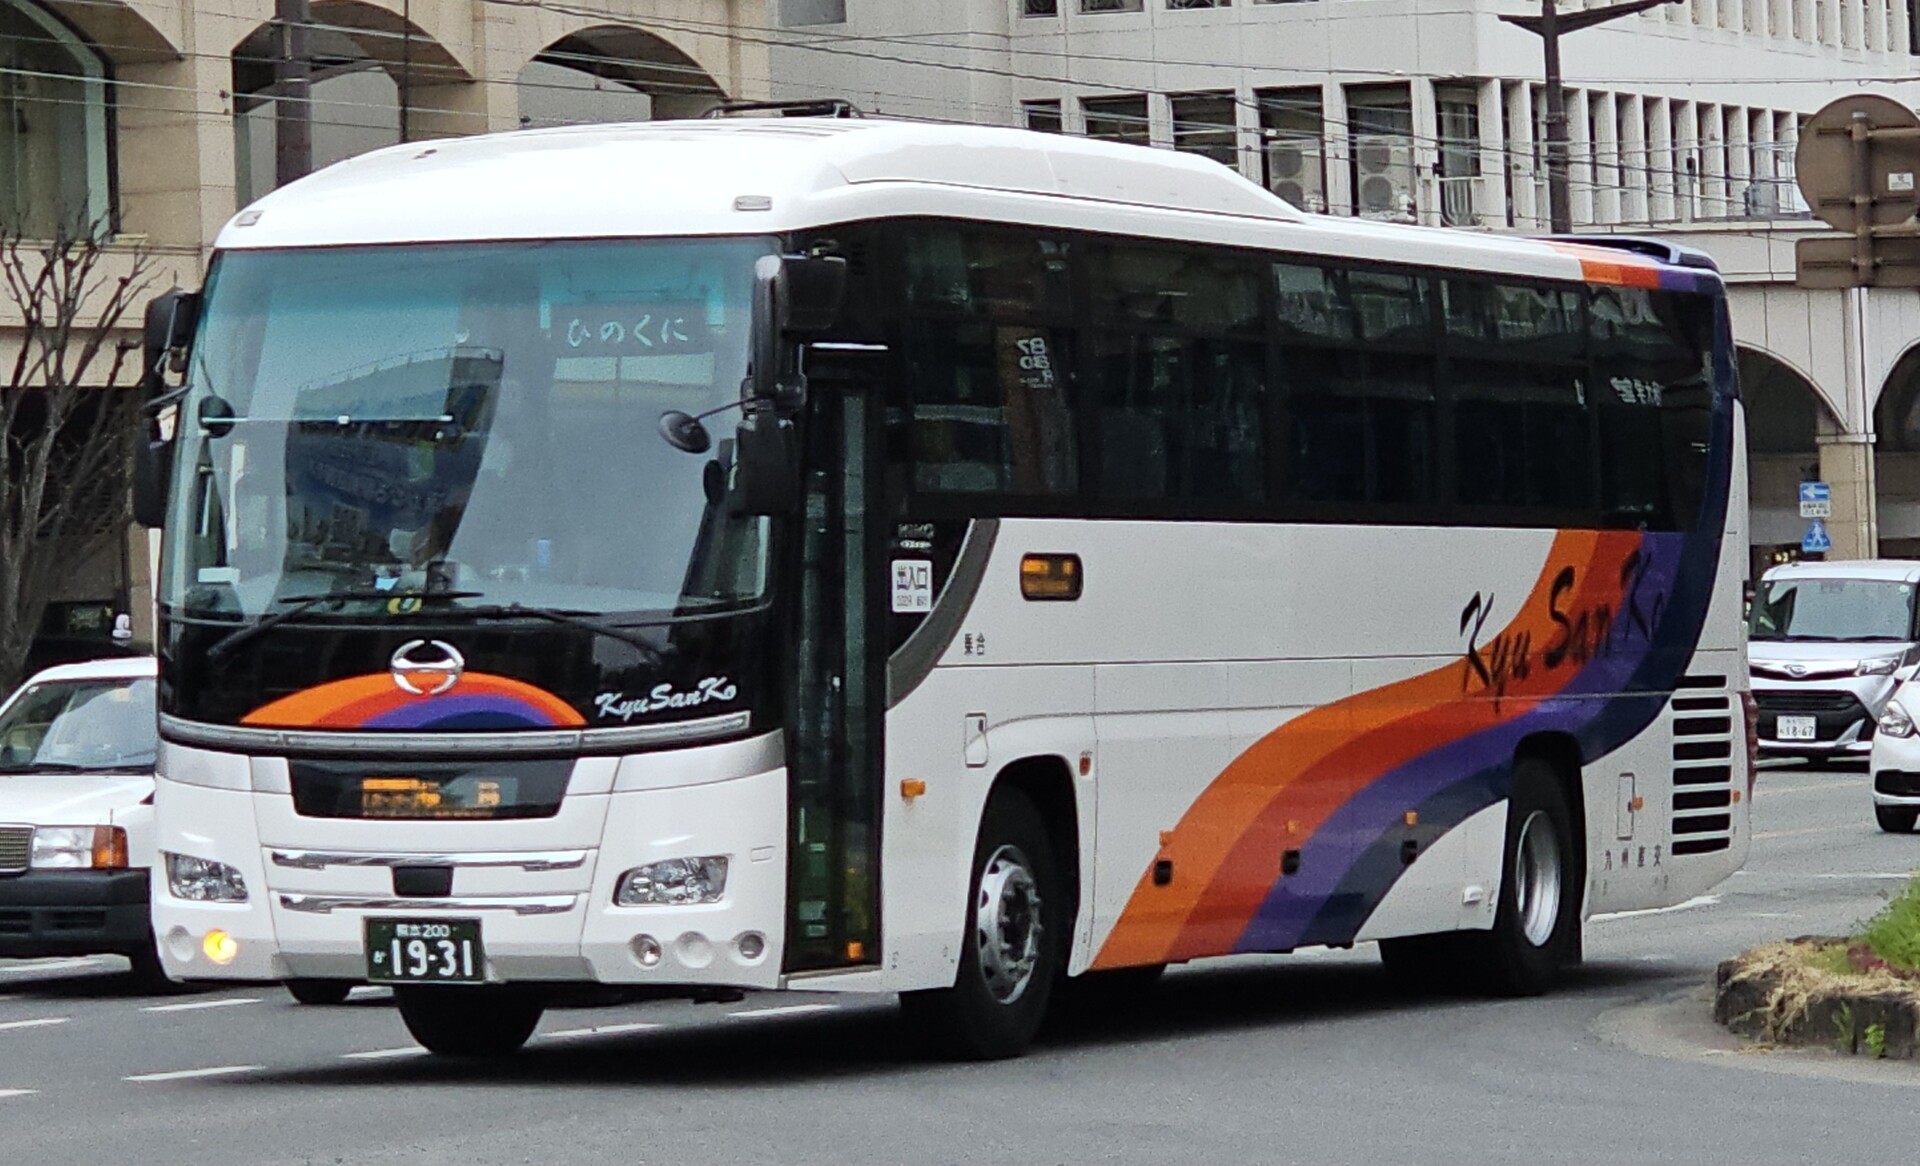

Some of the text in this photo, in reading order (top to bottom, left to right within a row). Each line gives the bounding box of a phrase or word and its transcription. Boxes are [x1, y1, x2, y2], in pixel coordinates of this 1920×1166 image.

[567, 314, 688, 348] ひのくに
[896, 565, 929, 590] 出入口
[1460, 590, 1531, 715] Kyu
[1544, 565, 1611, 669] San
[595, 676, 737, 722] KyuSanKo
